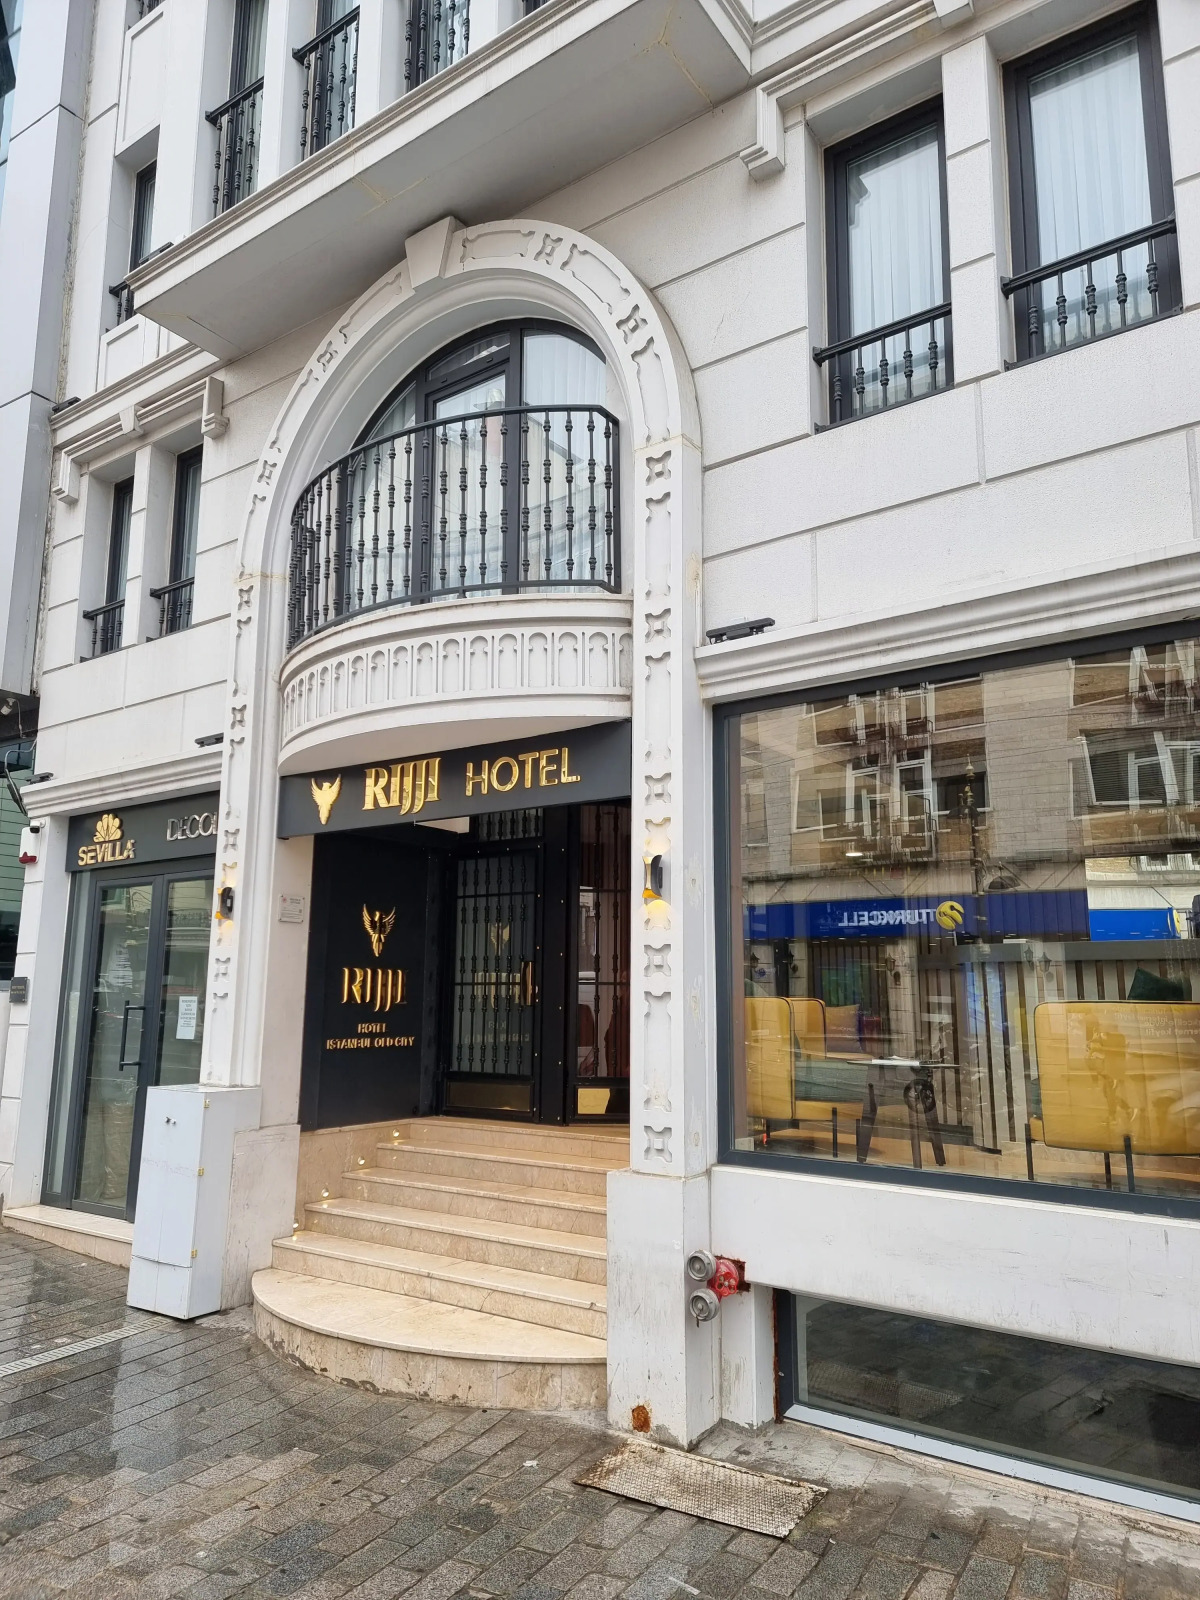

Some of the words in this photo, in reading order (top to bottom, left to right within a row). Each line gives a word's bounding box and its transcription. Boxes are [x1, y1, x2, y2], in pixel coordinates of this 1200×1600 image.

[362, 757, 442, 816] RIJJI
[464, 747, 581, 797] HOTEL
[374, 1037, 393, 1048] OLD
[394, 1036, 415, 1047] CITY
